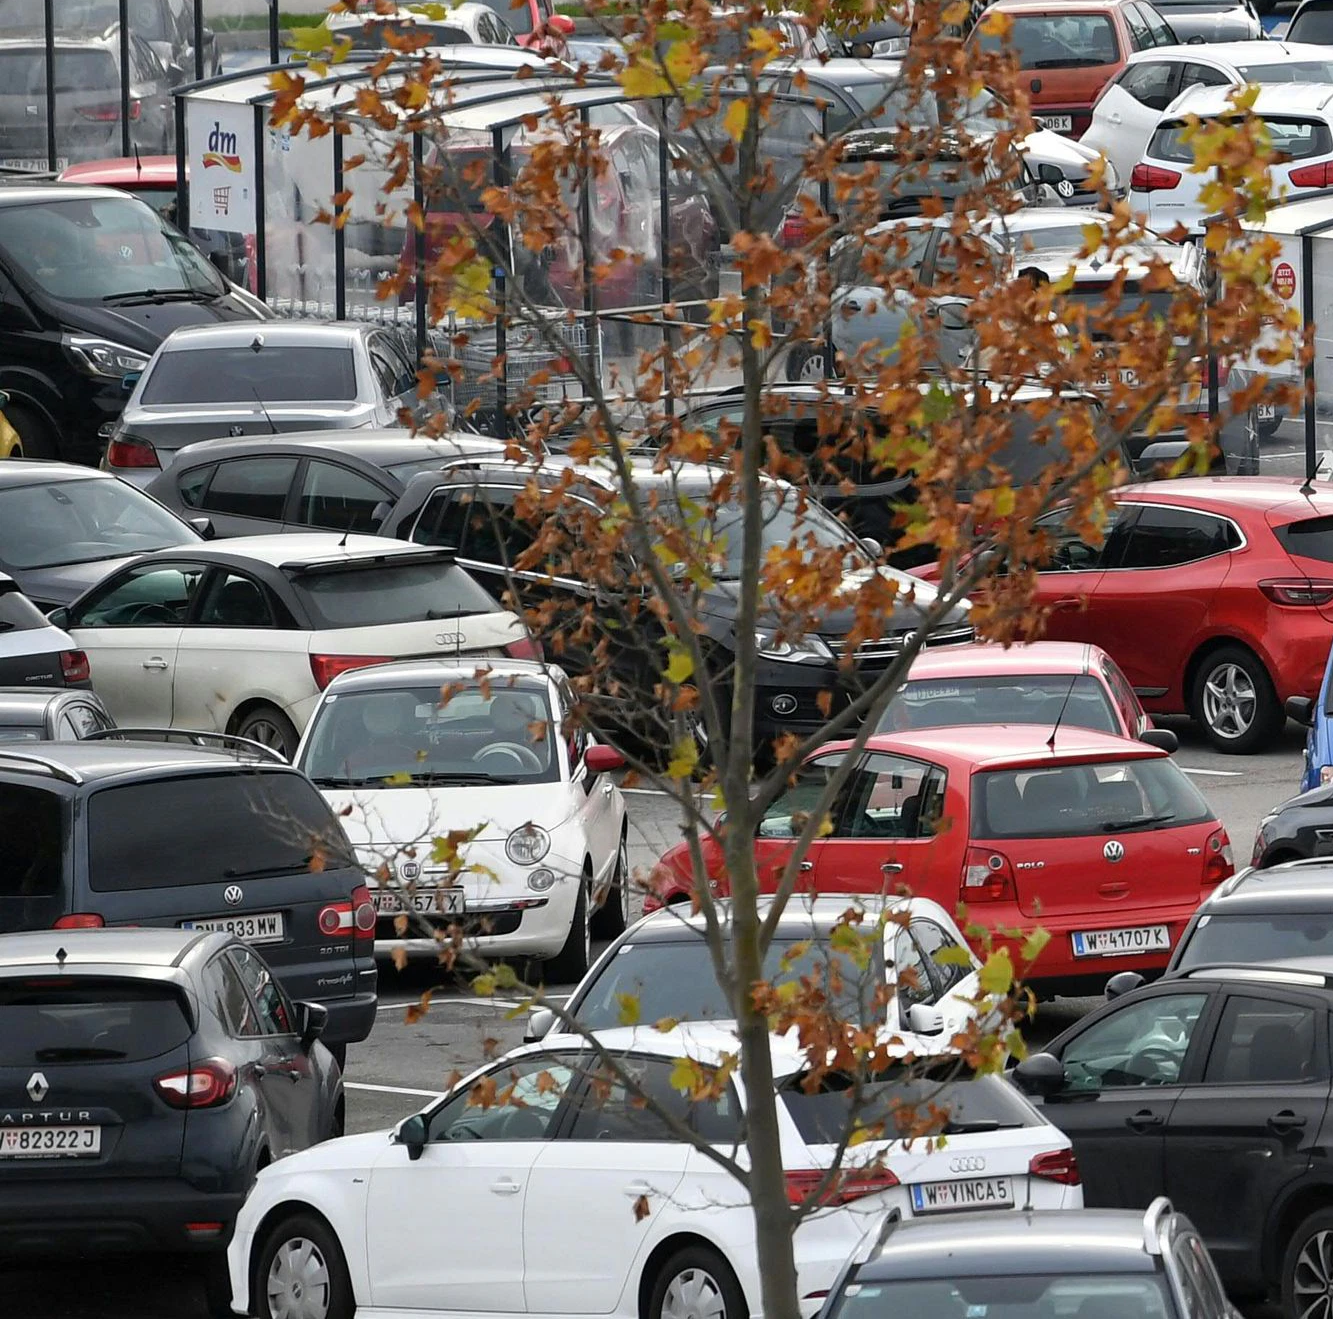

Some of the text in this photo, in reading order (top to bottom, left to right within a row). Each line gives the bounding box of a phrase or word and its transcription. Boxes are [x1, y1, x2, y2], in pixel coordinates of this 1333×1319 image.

[209, 122, 237, 155] dm
[1016, 860, 1045, 869] POLO
[447, 895, 458, 911] X
[226, 921, 255, 939] 833
[256, 919, 277, 936] MW
[1087, 928, 1164, 949] W 41707 K
[19, 1129, 95, 1151] 82322 J
[926, 1180, 1007, 1202] W VINCA 5
